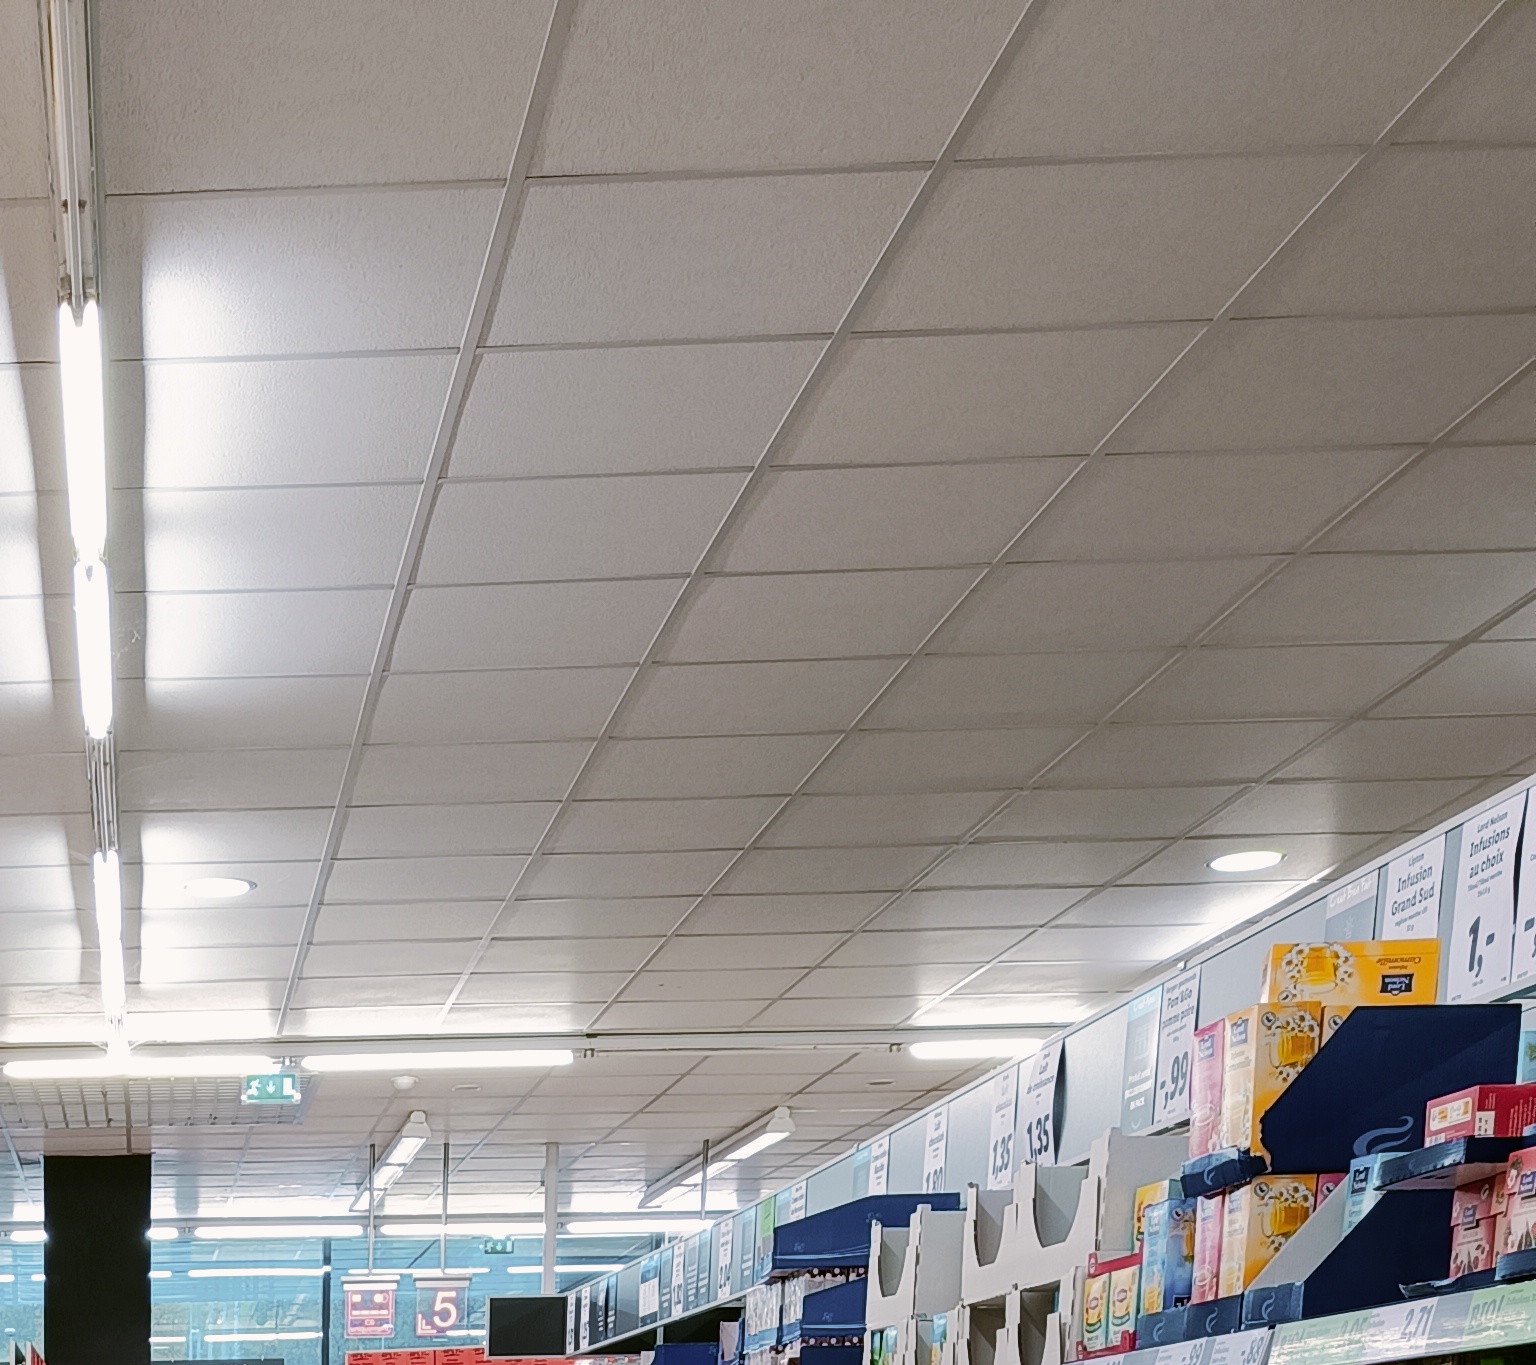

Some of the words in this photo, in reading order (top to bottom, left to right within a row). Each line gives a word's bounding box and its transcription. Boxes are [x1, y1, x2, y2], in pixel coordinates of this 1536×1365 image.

[1490, 812, 1508, 827] Nelson
[1469, 826, 1510, 858] Infusions
[1397, 865, 1433, 893] Infusion
[1469, 865, 1479, 879] au
[1480, 849, 1504, 875] choix
[1391, 893, 1417, 916] Grand
[1418, 882, 1435, 903] Sud
[1468, 916, 1495, 978] 1,-
[1159, 1051, 1189, 1109] -,99
[1027, 1114, 1050, 1160] 1,35
[992, 1132, 1013, 1180] 1,35
[433, 1290, 457, 1327] 5
